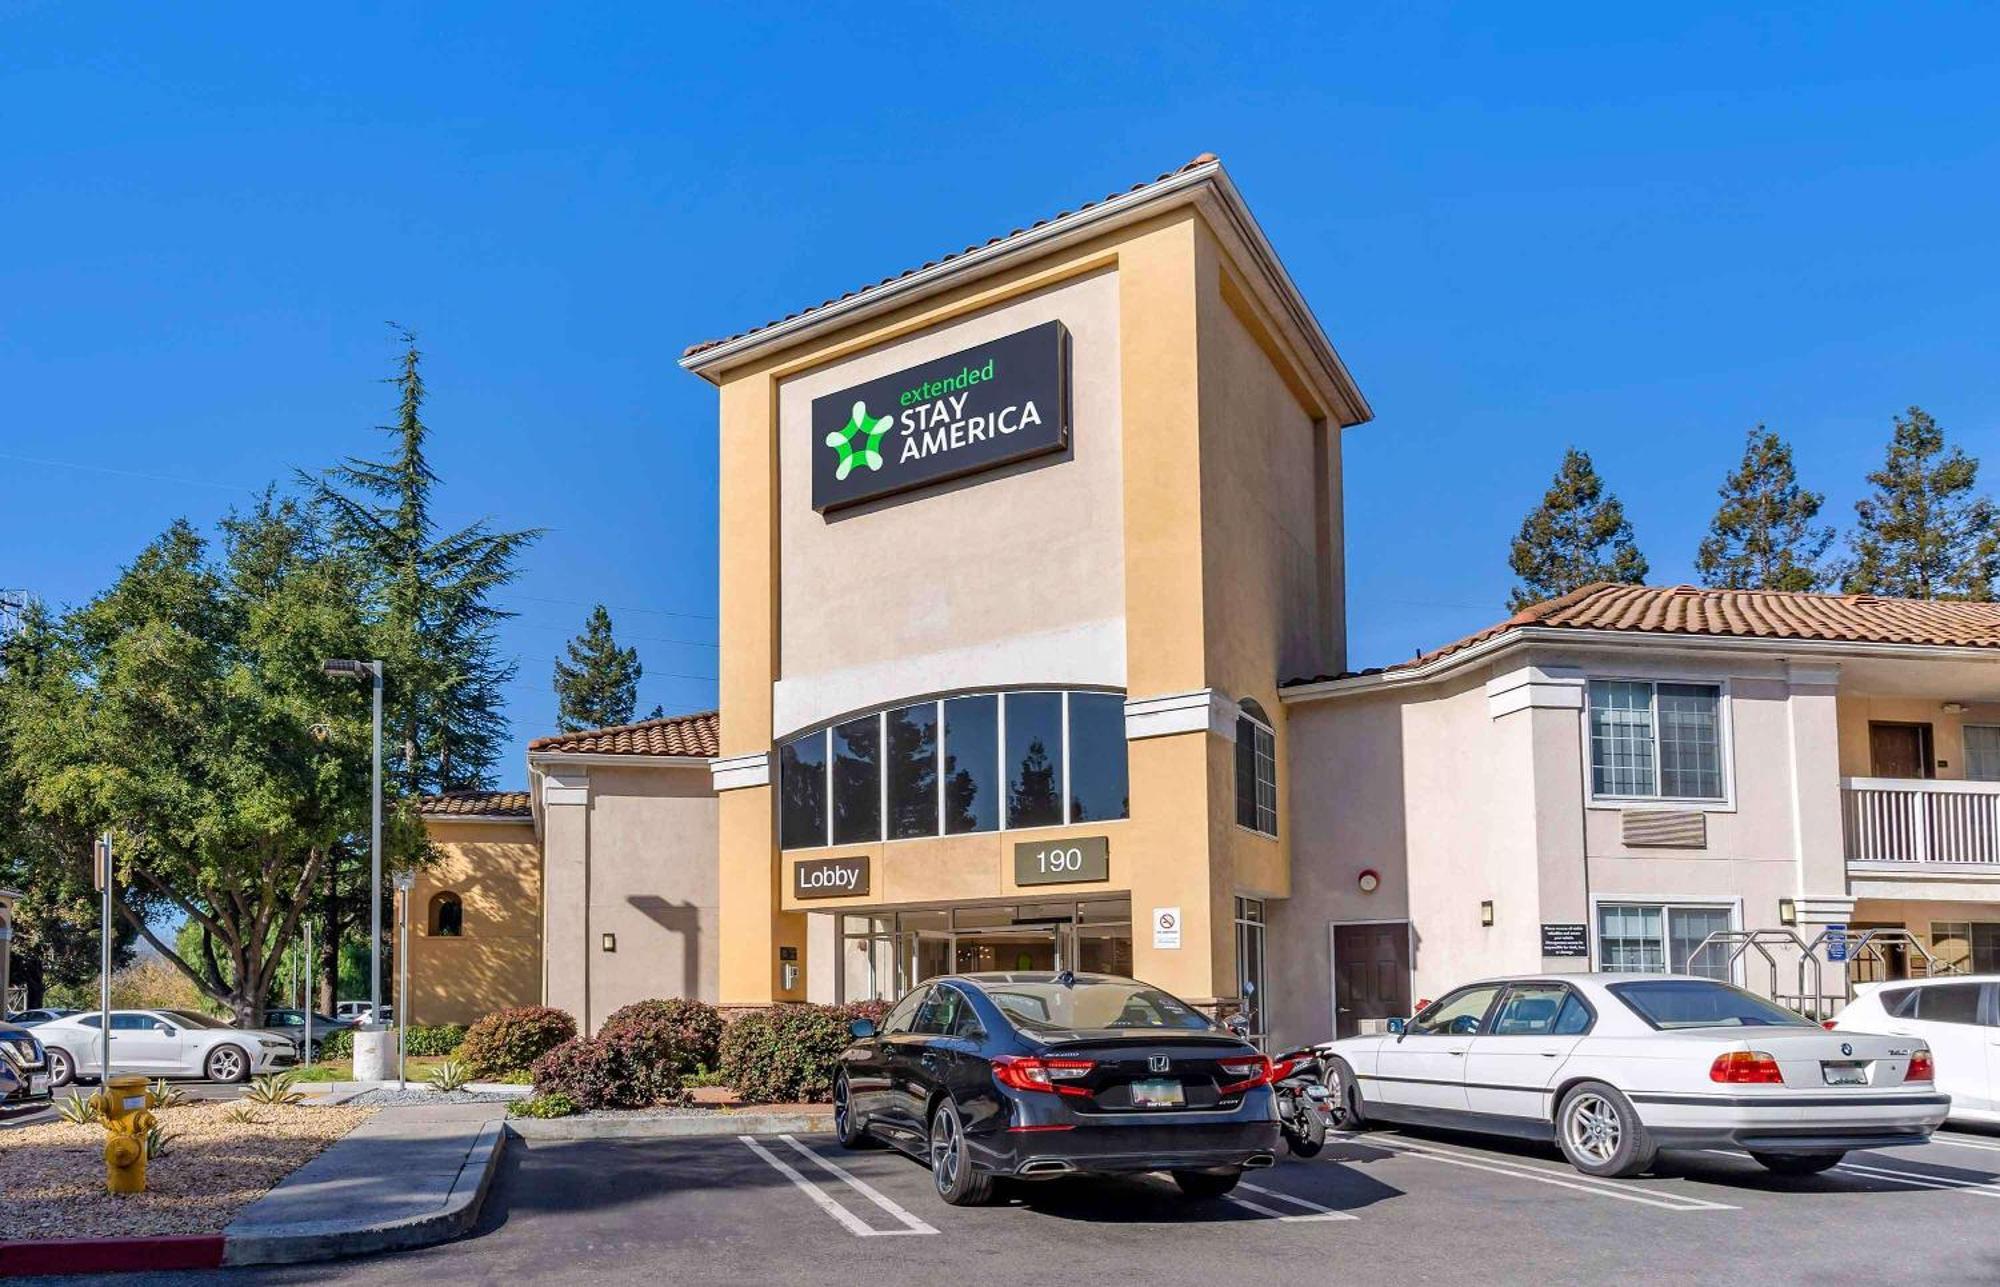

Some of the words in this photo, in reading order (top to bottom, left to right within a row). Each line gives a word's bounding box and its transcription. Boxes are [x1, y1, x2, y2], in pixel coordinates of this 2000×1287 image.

[900, 359, 994, 406] extended
[900, 401, 1042, 463] AMERICA
[901, 392, 969, 435] STAY
[800, 865, 859, 890] Lobby
[1036, 848, 1082, 873] 190
